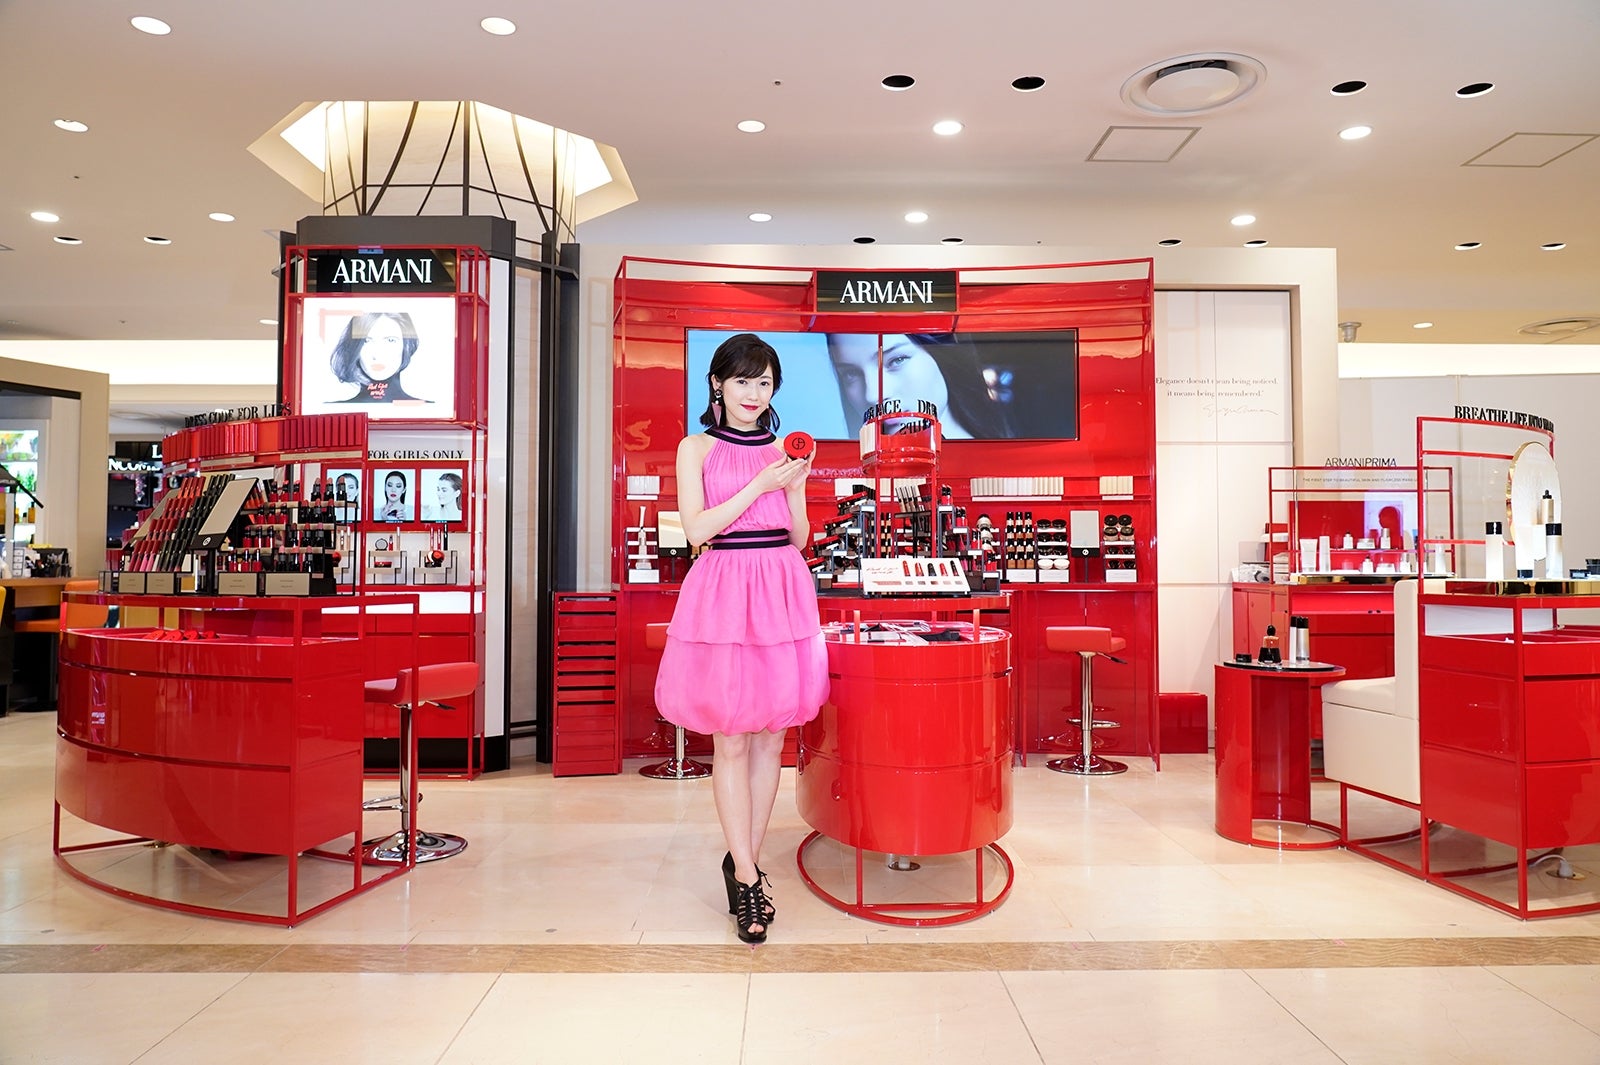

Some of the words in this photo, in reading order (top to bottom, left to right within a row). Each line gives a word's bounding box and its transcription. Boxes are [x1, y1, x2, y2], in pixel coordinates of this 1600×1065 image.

[332, 258, 433, 284] ARMANI
[840, 280, 933, 304] ARMANI
[185, 413, 206, 428] DRESS
[209, 409, 234, 423] CODE
[237, 406, 259, 420] FOR
[1454, 405, 1508, 423] BREATHE
[1510, 411, 1528, 426] LIFE
[368, 450, 389, 459] FOR
[393, 450, 430, 459] GIRLS
[433, 450, 464, 459] ONLY
